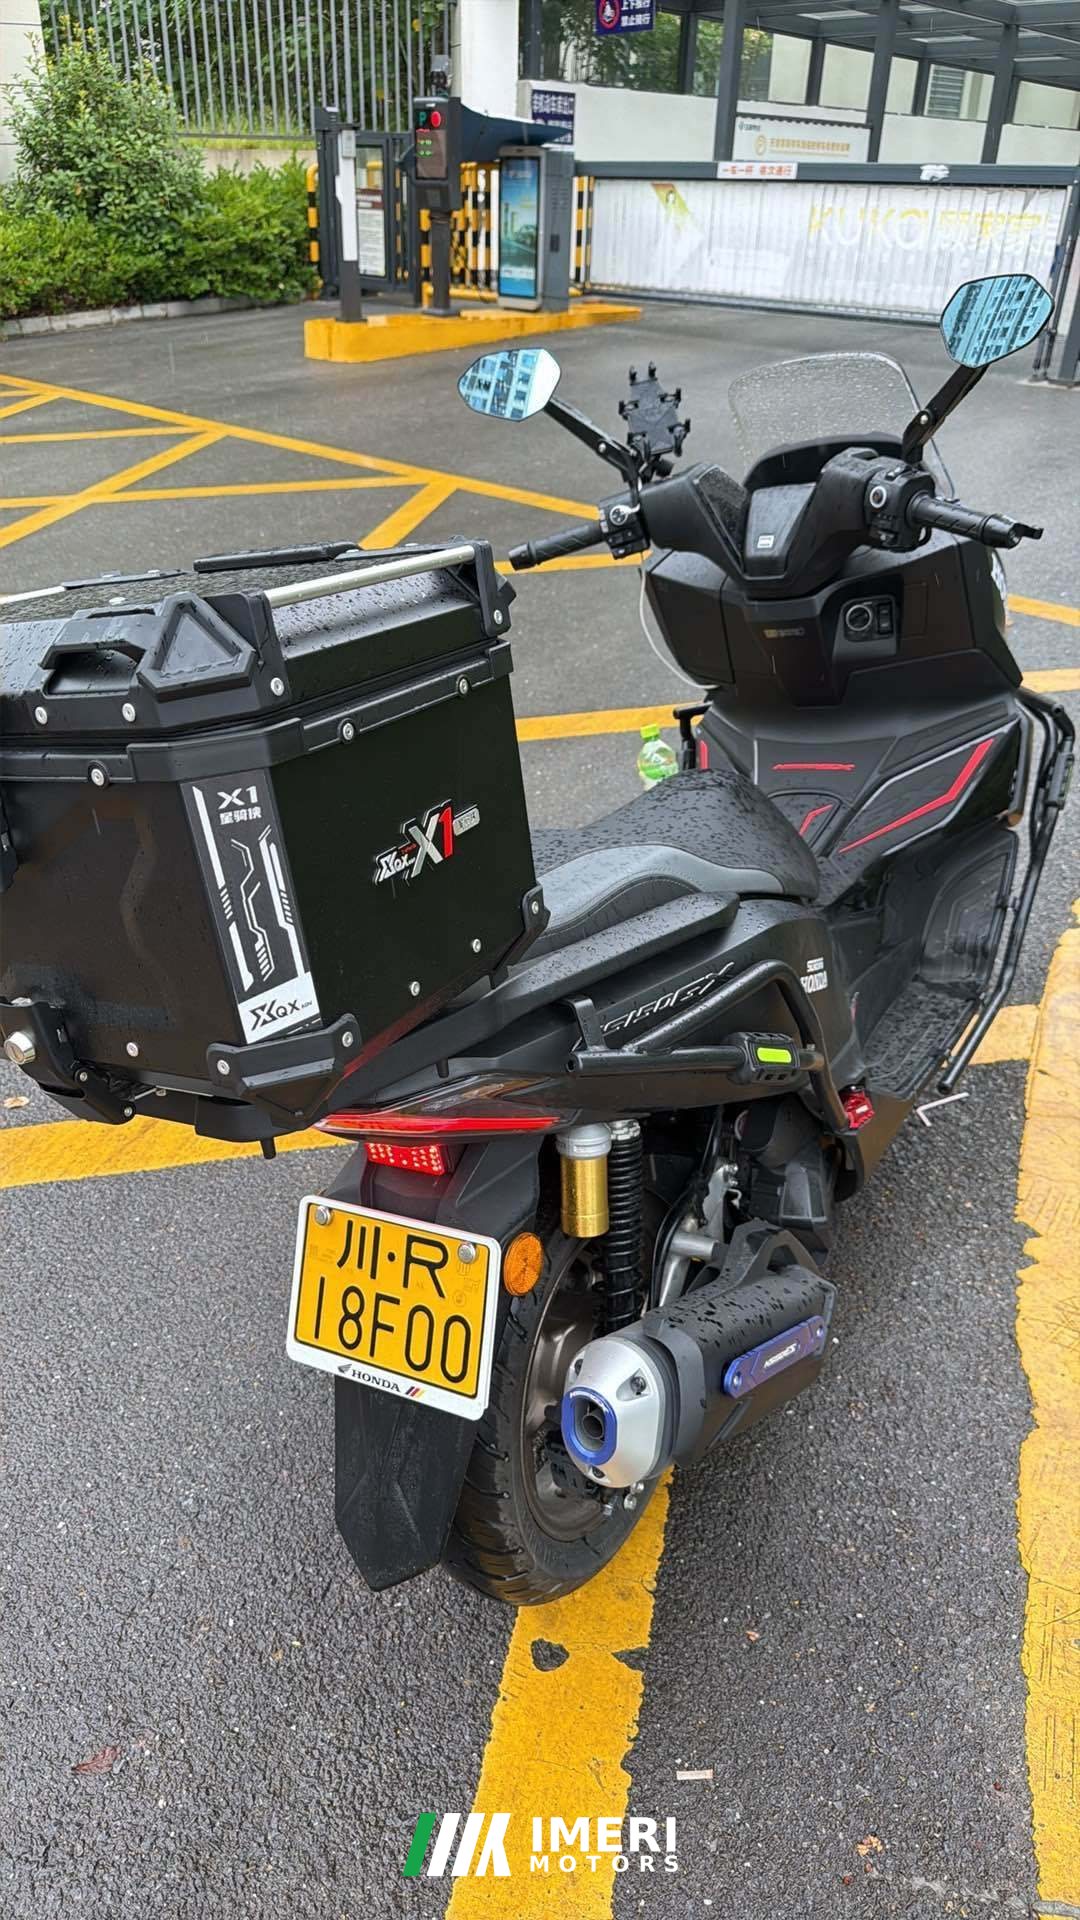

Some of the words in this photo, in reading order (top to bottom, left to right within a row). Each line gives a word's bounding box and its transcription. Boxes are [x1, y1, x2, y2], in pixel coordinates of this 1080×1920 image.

[217, 785, 258, 809] X1
[409, 806, 453, 878] X1
[314, 1276, 472, 1384] 18F00
[351, 1369, 400, 1392] HONDA
